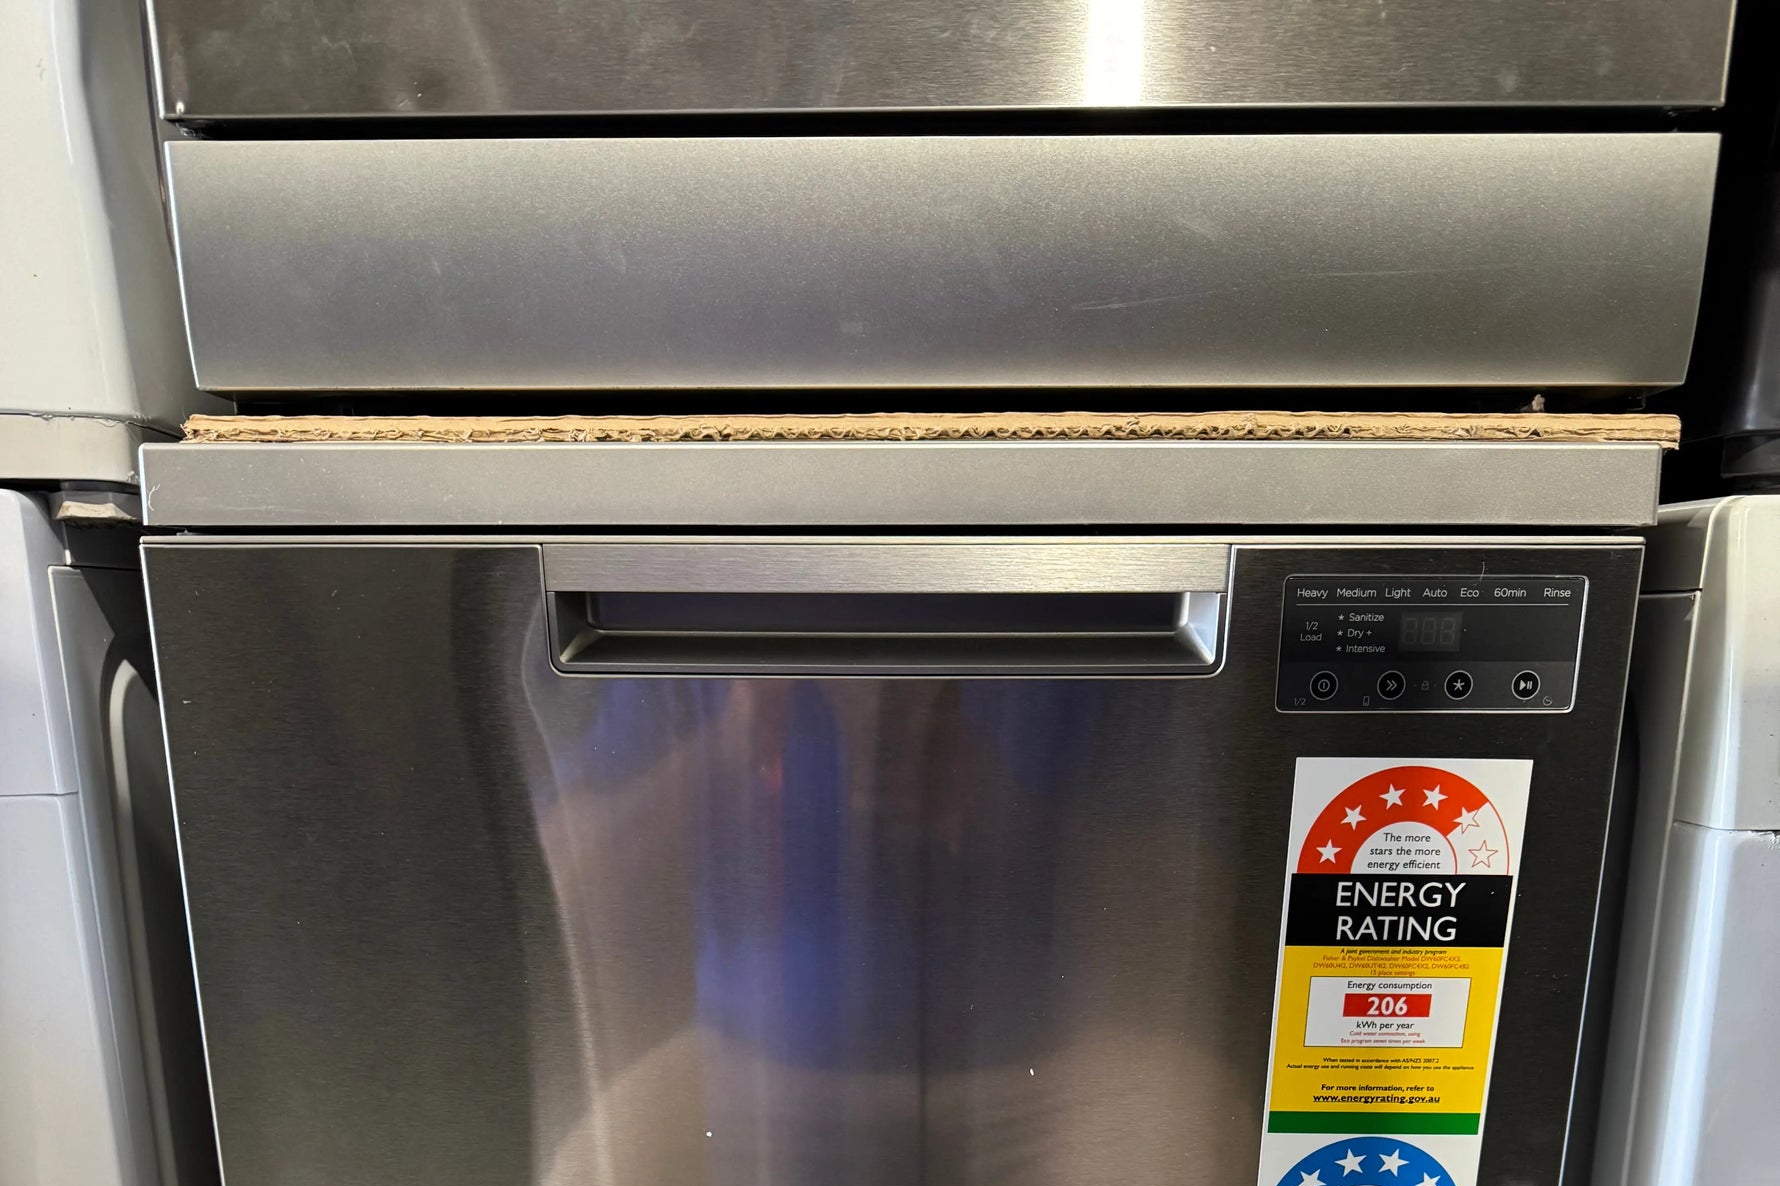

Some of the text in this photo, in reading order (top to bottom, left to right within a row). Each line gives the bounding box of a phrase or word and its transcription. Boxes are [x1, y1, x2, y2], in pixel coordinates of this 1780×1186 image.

[1297, 587, 1571, 600] Heavy Medium Light Auto Eco 60min Rinse
[1348, 612, 1385, 622] Sanitize
[1305, 621, 1319, 631] 1/2
[1300, 633, 1322, 642] Load
[1347, 628, 1364, 639] Dry
[1345, 644, 1386, 653] Intensive
[1383, 832, 1431, 843] The more
[1369, 847, 1441, 856] stars the more
[1367, 860, 1441, 872] energy efficient
[1335, 881, 1466, 908] ENERGY
[1335, 915, 1457, 941] RATING
[1347, 981, 1433, 991] Energy consumption
[1366, 996, 1408, 1016] 206
[1356, 1020, 1415, 1031] kWh per year
[1358, 1084, 1405, 1093] information,
[1313, 1093, 1441, 1104] www.energyrating.gov.au
